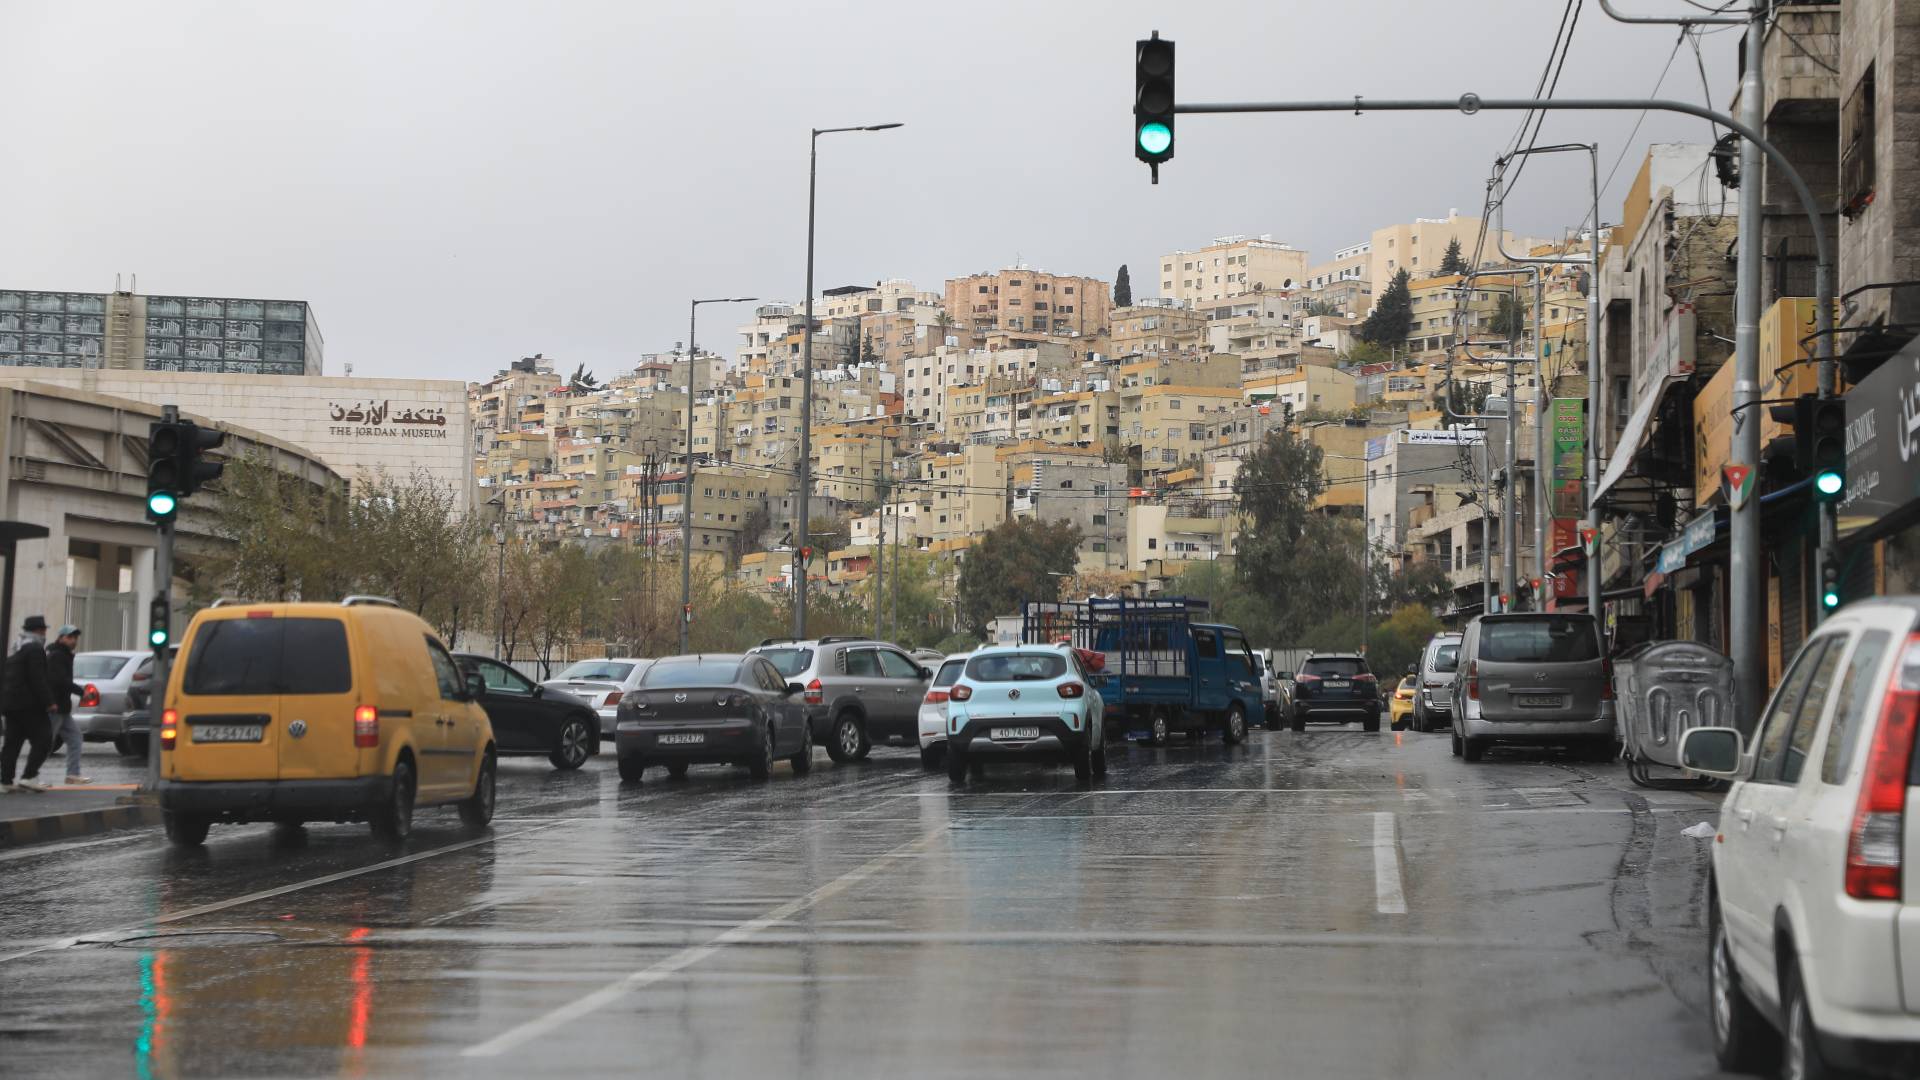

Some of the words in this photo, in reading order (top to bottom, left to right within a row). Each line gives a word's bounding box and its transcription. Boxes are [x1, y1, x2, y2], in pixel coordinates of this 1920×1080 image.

[329, 427, 351, 436] THE
[356, 427, 397, 438] JORDAN
[401, 429, 446, 439] MUSEUM
[1855, 408, 1877, 449] SMOKE
